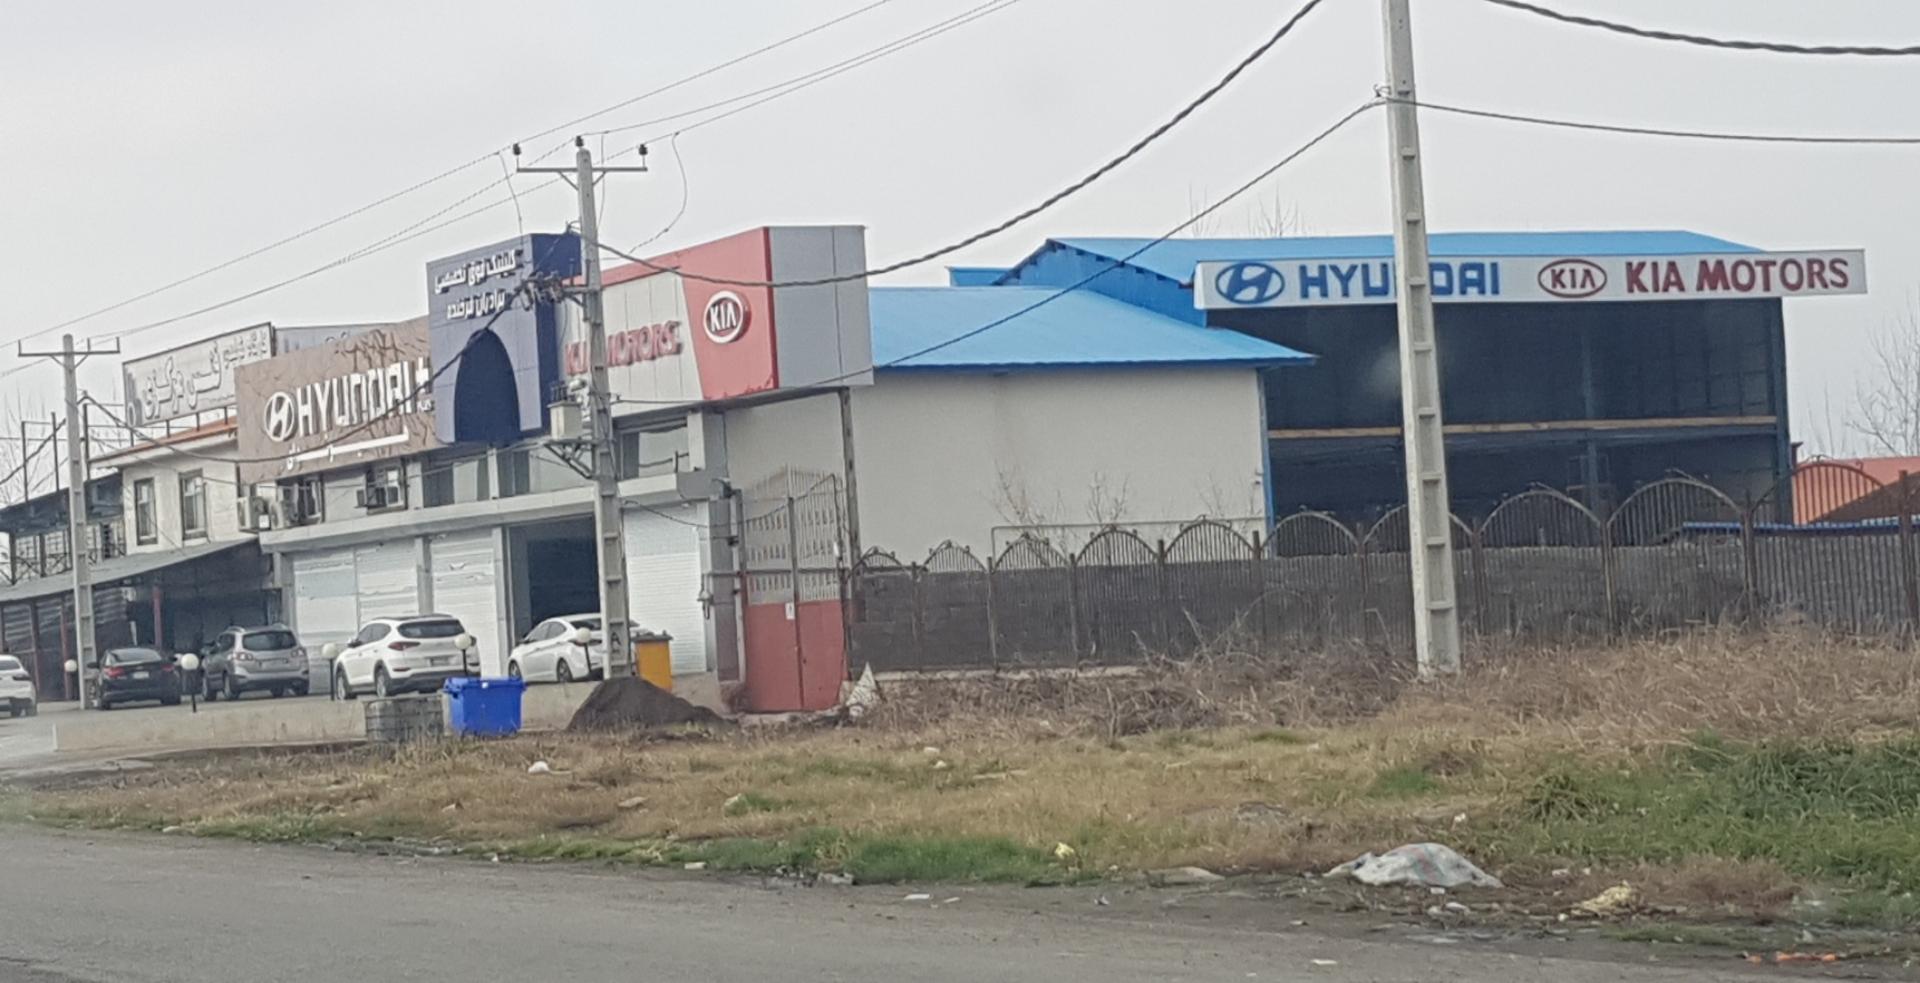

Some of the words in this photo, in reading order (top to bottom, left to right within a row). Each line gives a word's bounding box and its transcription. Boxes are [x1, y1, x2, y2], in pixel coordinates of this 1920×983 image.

[1300, 262, 1500, 298] HYUDAI
[1551, 268, 1595, 289] KIA
[1625, 261, 1685, 293] KIA
[1696, 258, 1849, 292] MOTORS
[709, 301, 737, 332] KIA
[565, 340, 589, 375] KI
[297, 360, 412, 437] HYUNDAI
